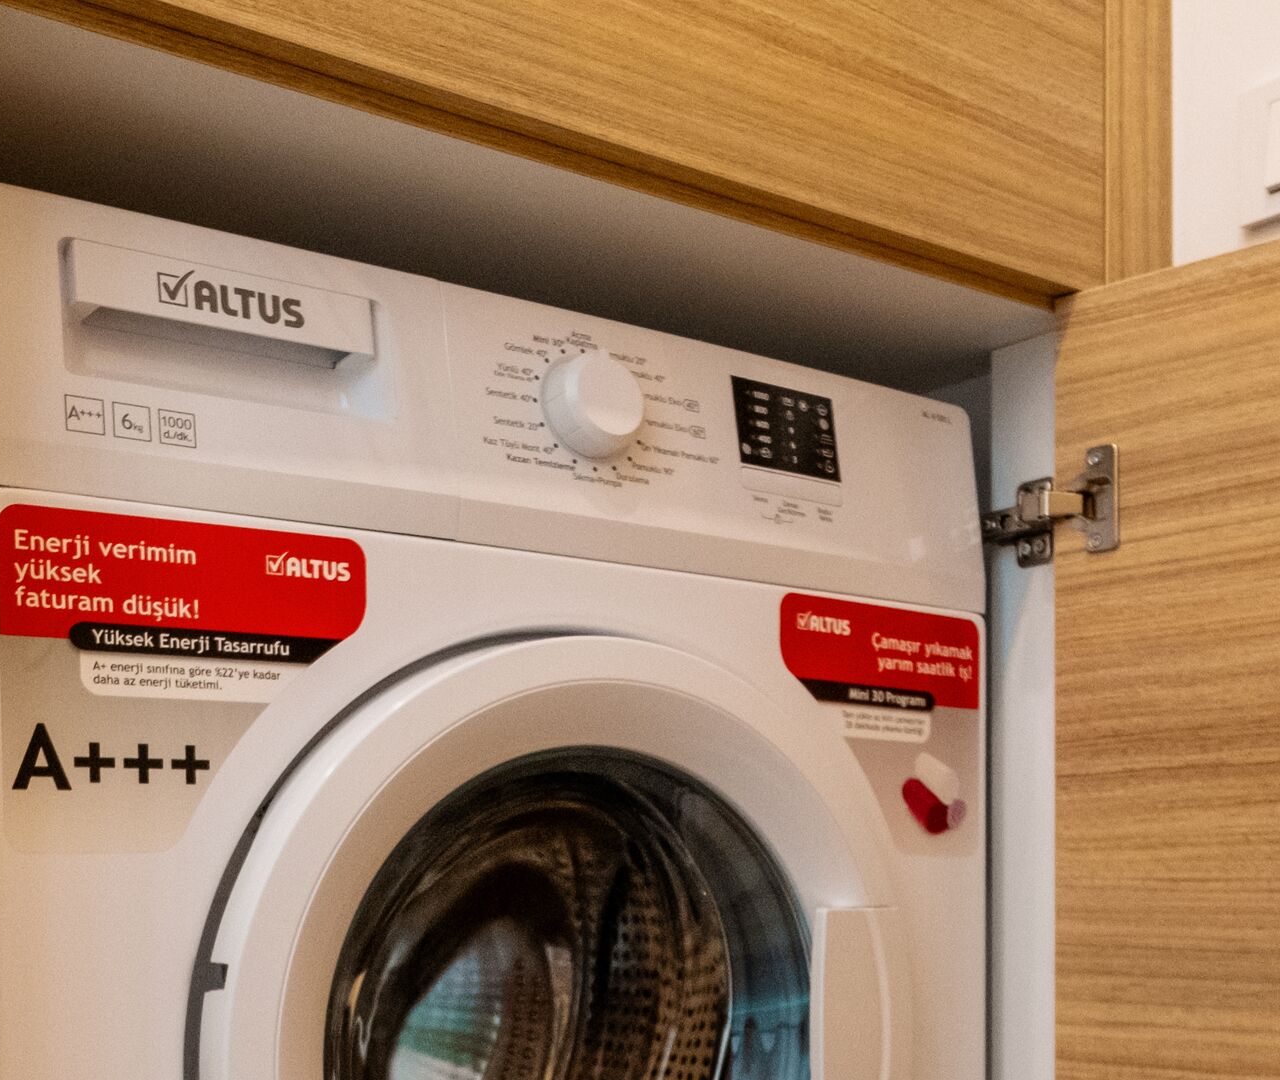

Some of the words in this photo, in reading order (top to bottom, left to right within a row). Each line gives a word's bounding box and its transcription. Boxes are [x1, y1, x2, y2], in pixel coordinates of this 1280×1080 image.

[193, 279, 305, 329] ALTUS
[67, 405, 103, 420] A+++
[161, 416, 192, 430] 1000
[14, 528, 90, 560] Enerji
[98, 540, 197, 565] verimim
[14, 558, 102, 584] yüksek
[285, 556, 351, 582] ALTUS
[15, 585, 114, 613] faturam
[122, 594, 200, 622] düşük!
[810, 615, 851, 636] ALTUS
[92, 628, 154, 648] Yüksek
[159, 633, 210, 654] Enerji
[214, 637, 290, 656] Tasarrufu
[871, 632, 922, 656] Çamaşır
[924, 641, 973, 661] yıkamak
[93, 661, 106, 671] A+
[110, 662, 143, 675] enerji
[146, 664, 186, 676] sınıfına
[189, 666, 212, 678] göre
[214, 667, 250, 680] %22'ye
[252, 669, 281, 680] kadar
[877, 656, 914, 672] yarım
[917, 661, 955, 677] saatlik
[958, 664, 973, 682] iş!
[93, 674, 120, 686] daha
[123, 677, 136, 686] az
[139, 677, 171, 689] enerji
[175, 679, 223, 691] tüketimi.
[848, 687, 869, 701] Mini
[872, 690, 885, 703] 30
[11, 722, 211, 791] A+++
